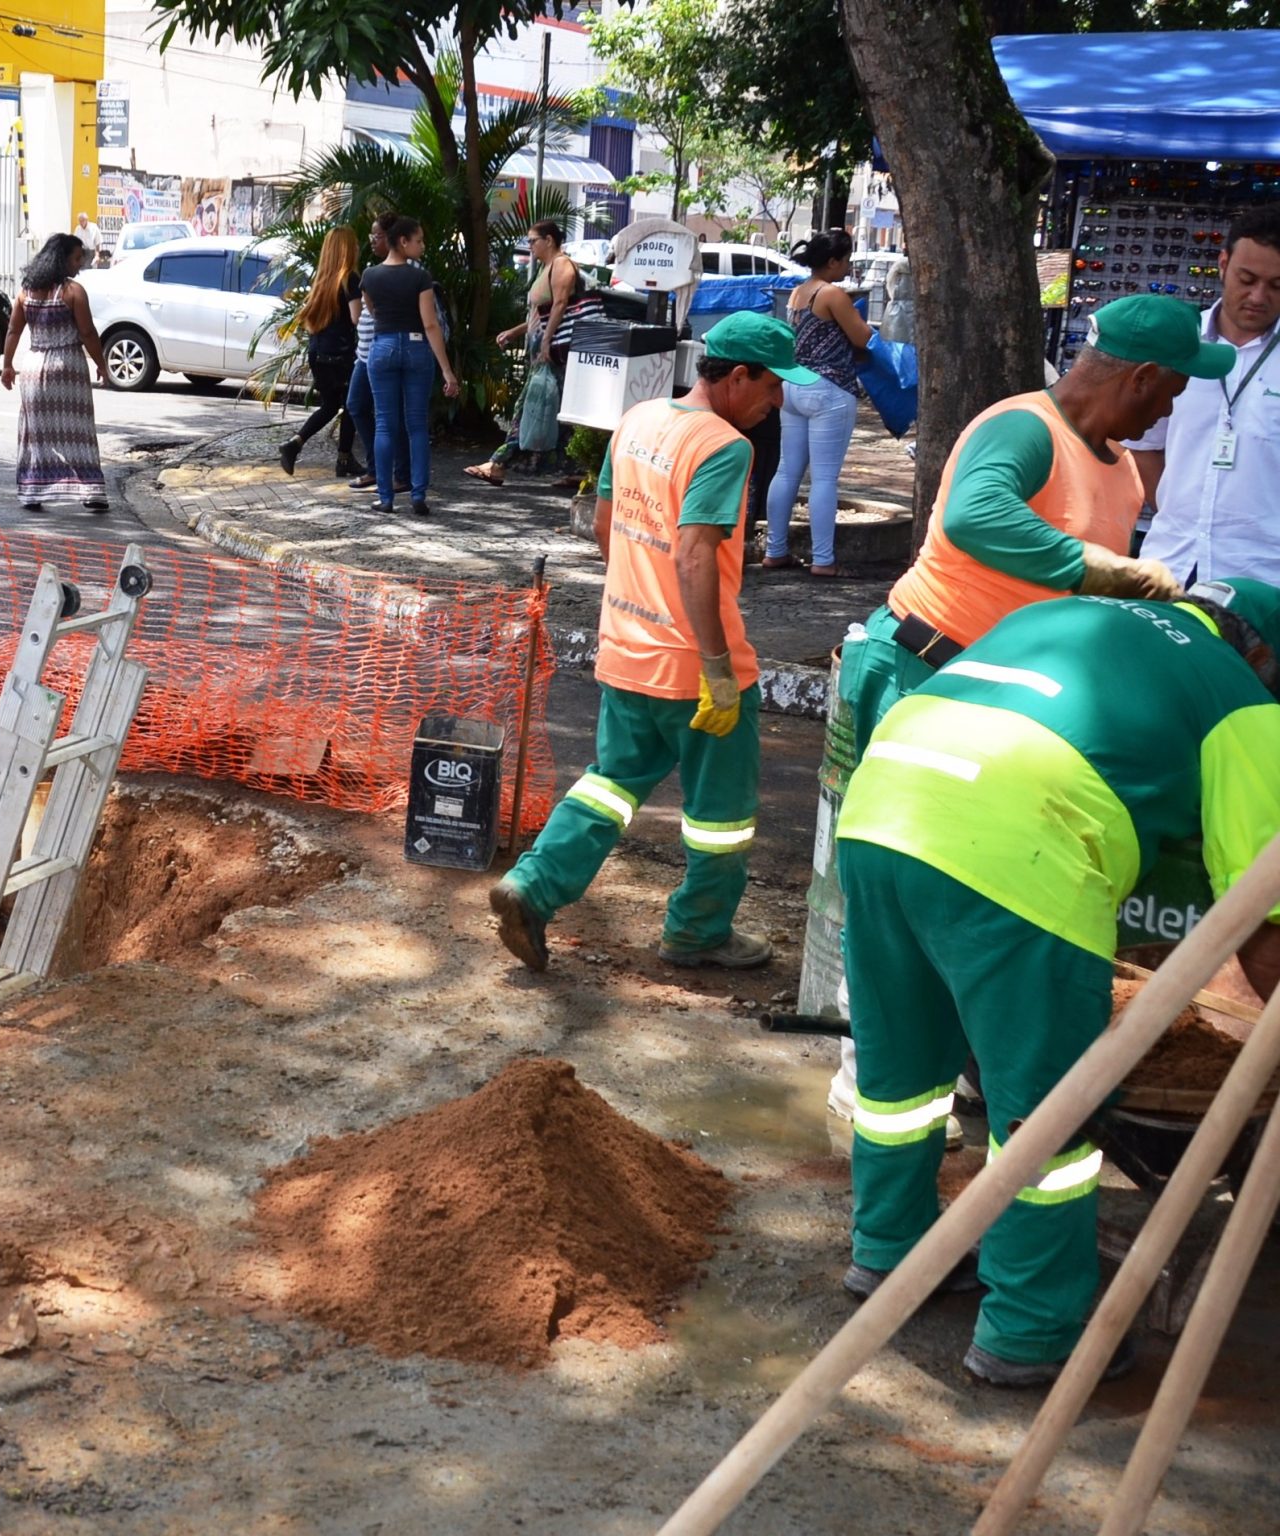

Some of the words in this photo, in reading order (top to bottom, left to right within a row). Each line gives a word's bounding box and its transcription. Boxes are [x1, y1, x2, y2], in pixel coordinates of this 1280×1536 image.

[636, 241, 674, 255] PROJETO
[634, 257, 647, 266] LIXO
[648, 258, 656, 267] NA
[657, 257, 674, 268] CESTA
[578, 352, 620, 370] LIXEIRA
